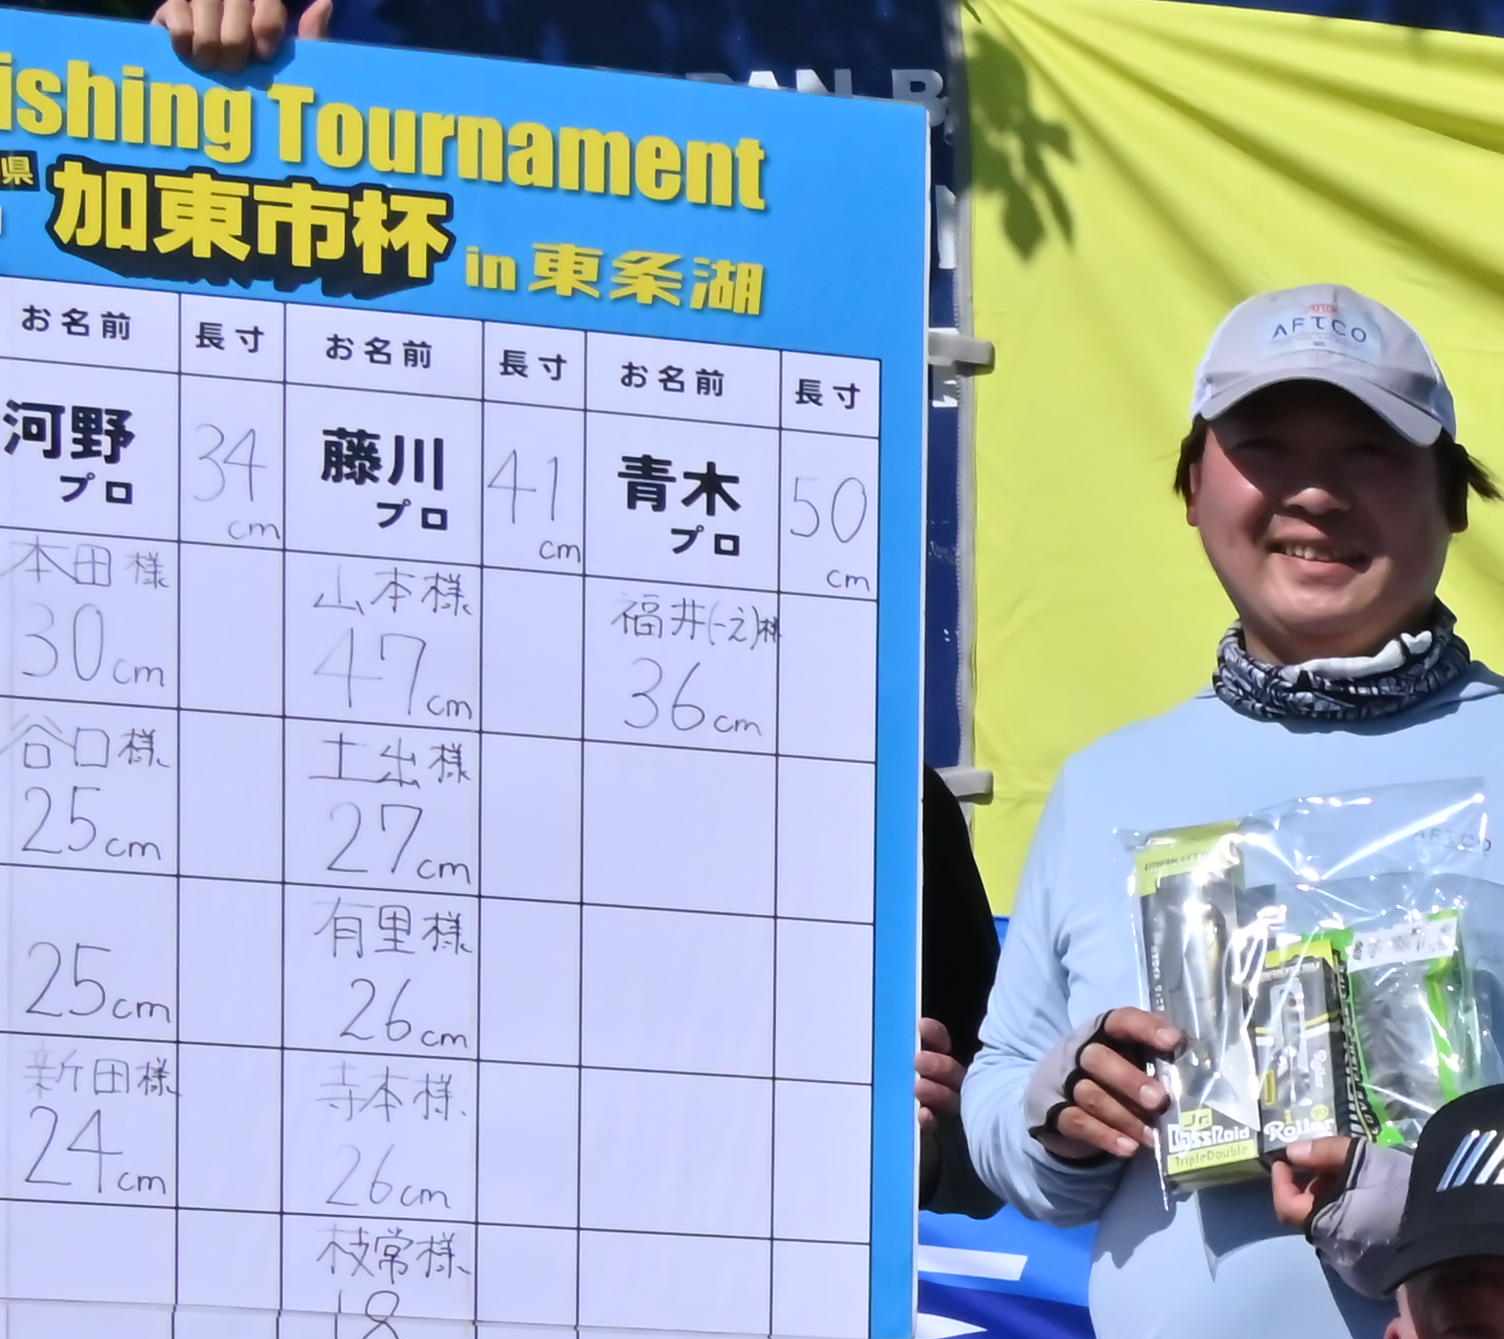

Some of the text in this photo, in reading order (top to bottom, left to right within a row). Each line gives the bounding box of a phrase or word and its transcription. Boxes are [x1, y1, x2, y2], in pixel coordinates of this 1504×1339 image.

[267, 83, 766, 211] Tournament
[53, 160, 765, 316] 加東市杯 in 東条湖
[20, 303, 133, 343] お名前
[194, 321, 266, 355] 長寸
[325, 333, 433, 370] お名前
[499, 350, 569, 384] 長寸
[620, 361, 727, 397] お名前
[795, 379, 862, 411] 長寸
[3, 402, 135, 463] 河野
[321, 428, 446, 490] 藤川
[59, 471, 134, 506] プロ
[192, 426, 282, 540] 34 cm
[376, 496, 449, 531] プロ
[488, 450, 582, 563] 41 cm
[617, 458, 743, 516] 青木
[670, 524, 741, 557] プロ
[790, 476, 870, 591] 50 cm
[313, 563, 471, 616] 山本様
[22, 603, 165, 687] 30 cm
[313, 627, 472, 719] 47 cm
[624, 658, 762, 736] 36 cm
[22, 785, 161, 860] 25 cm
[326, 802, 470, 884] 27 cm
[25, 941, 171, 1022] 25 cm
[339, 978, 468, 1048] 26 cm
[25, 1105, 166, 1194] 24 cm
[326, 1143, 451, 1208] 26 cm
